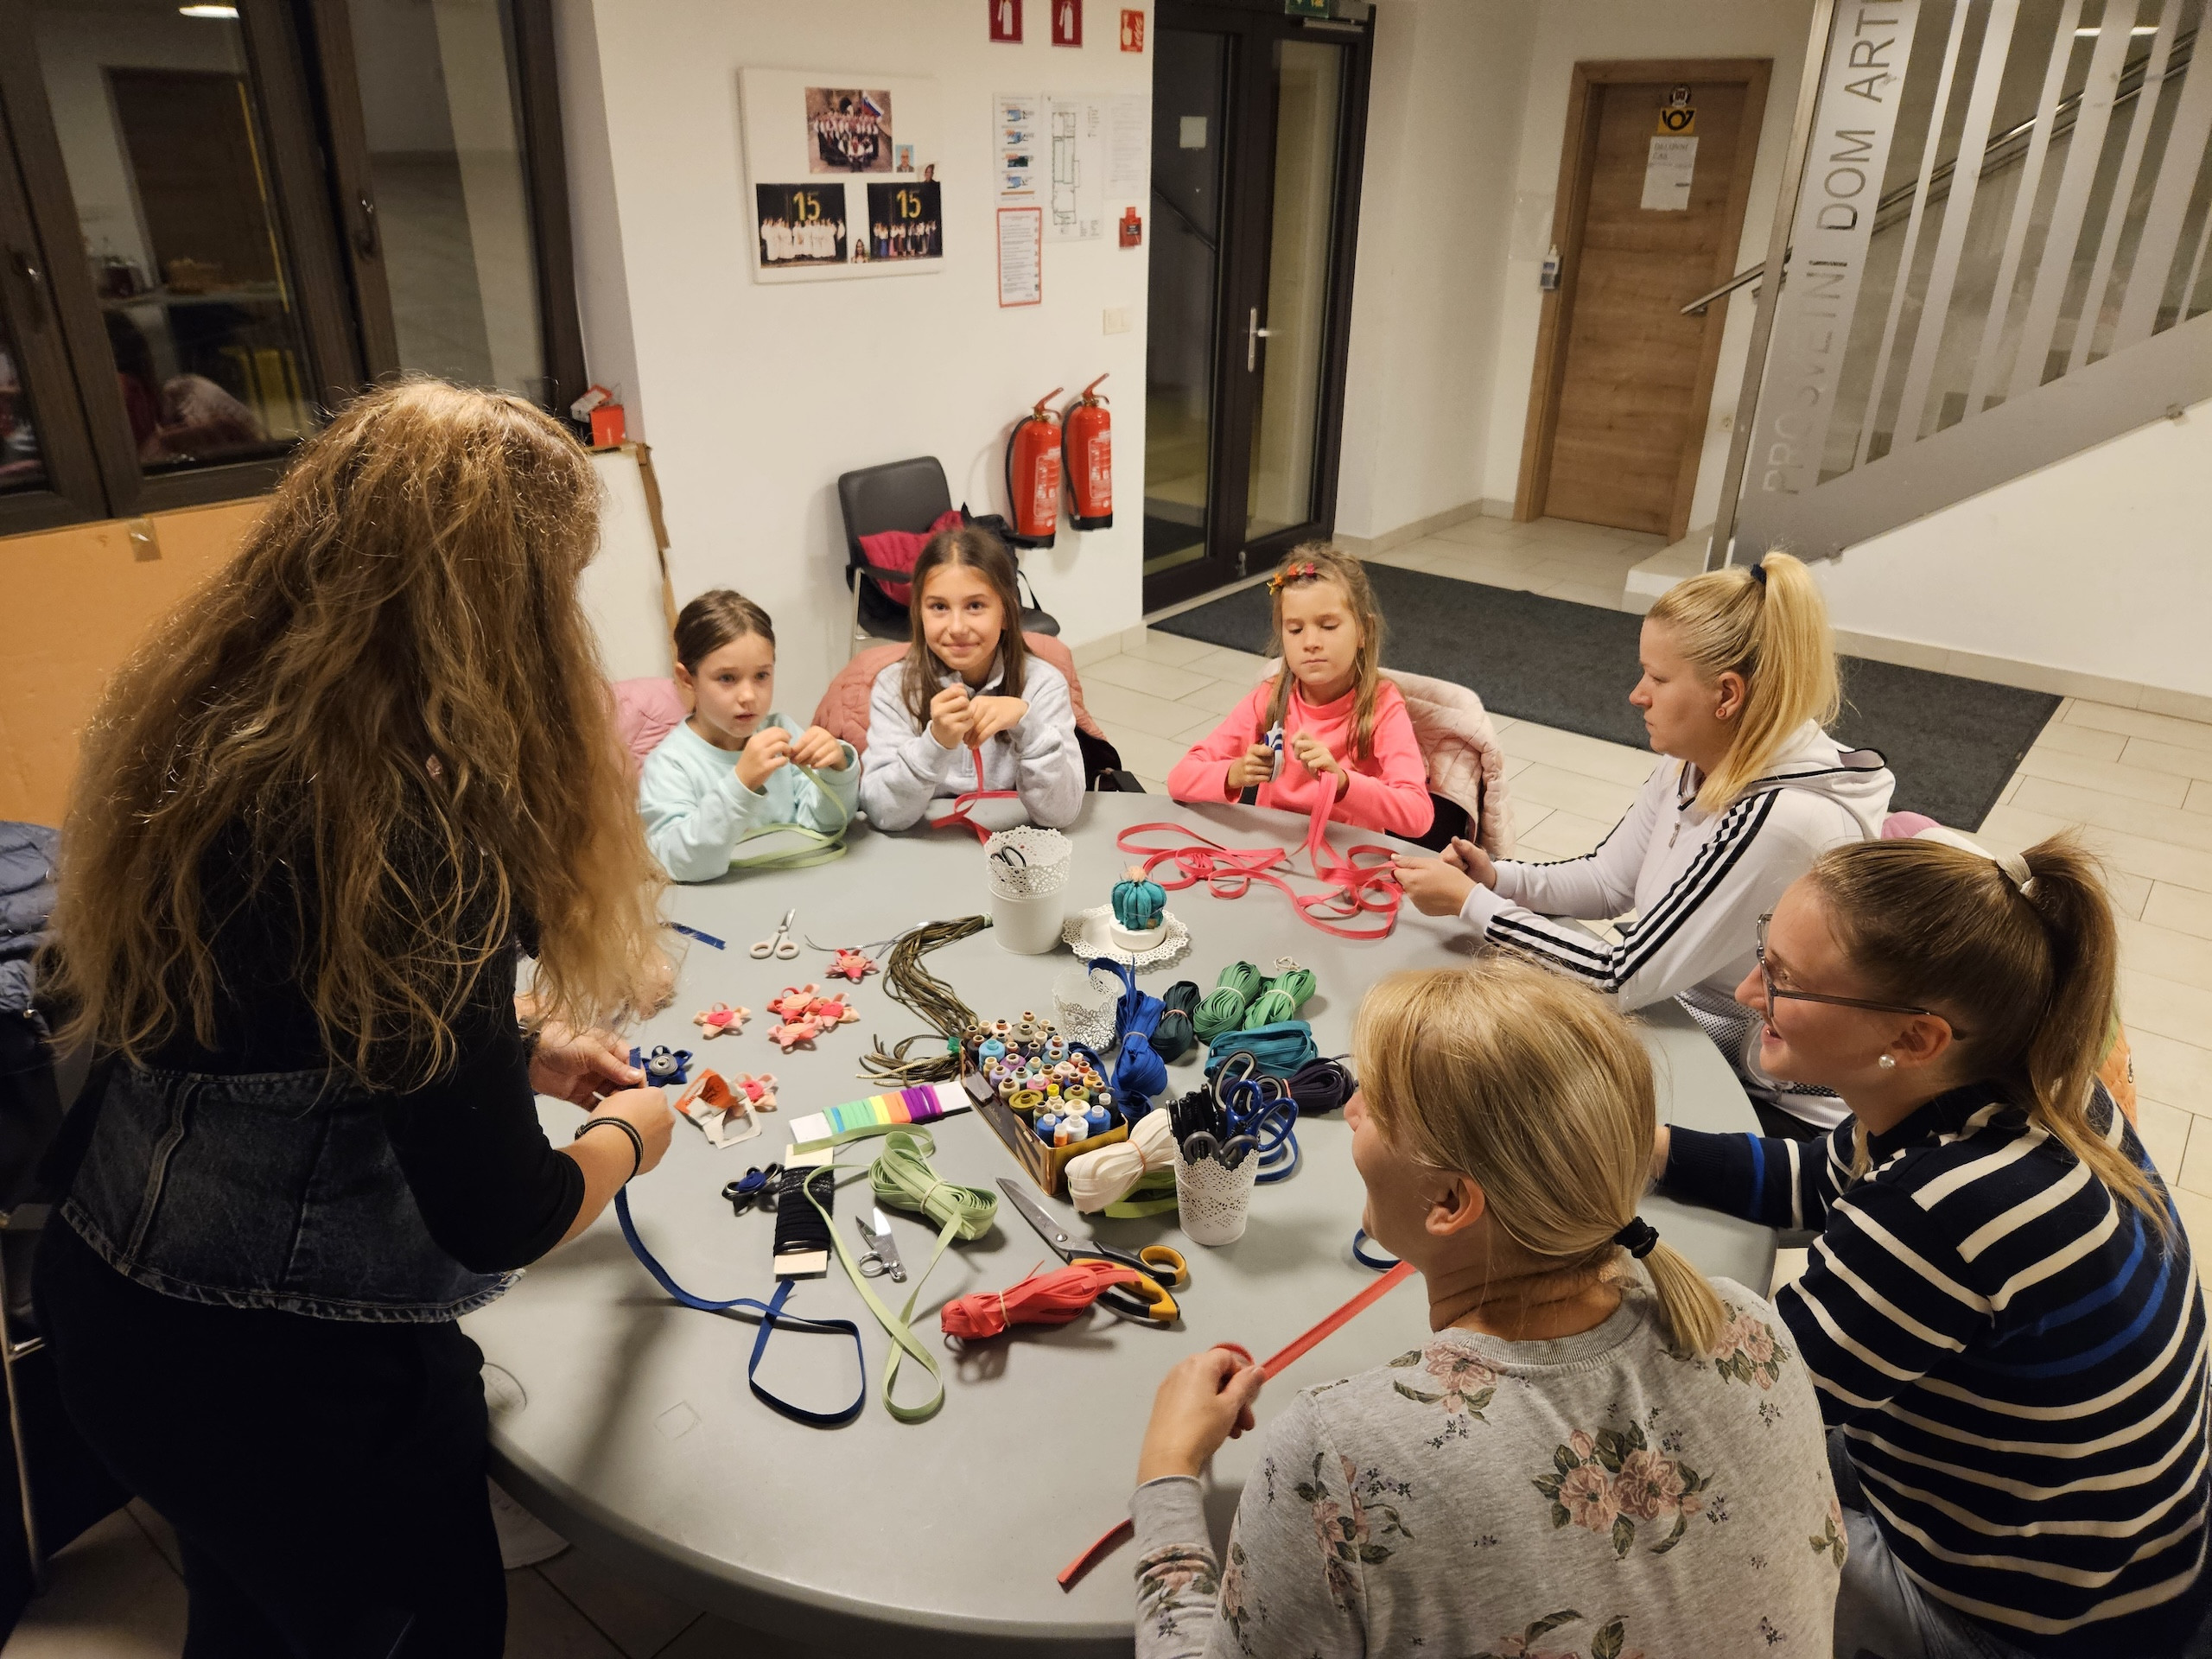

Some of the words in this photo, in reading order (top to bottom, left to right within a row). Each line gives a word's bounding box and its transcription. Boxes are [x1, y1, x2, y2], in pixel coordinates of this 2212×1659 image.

[1816, 130, 1876, 230] DOM
[792, 189, 821, 222] 15
[896, 188, 922, 219] 15
